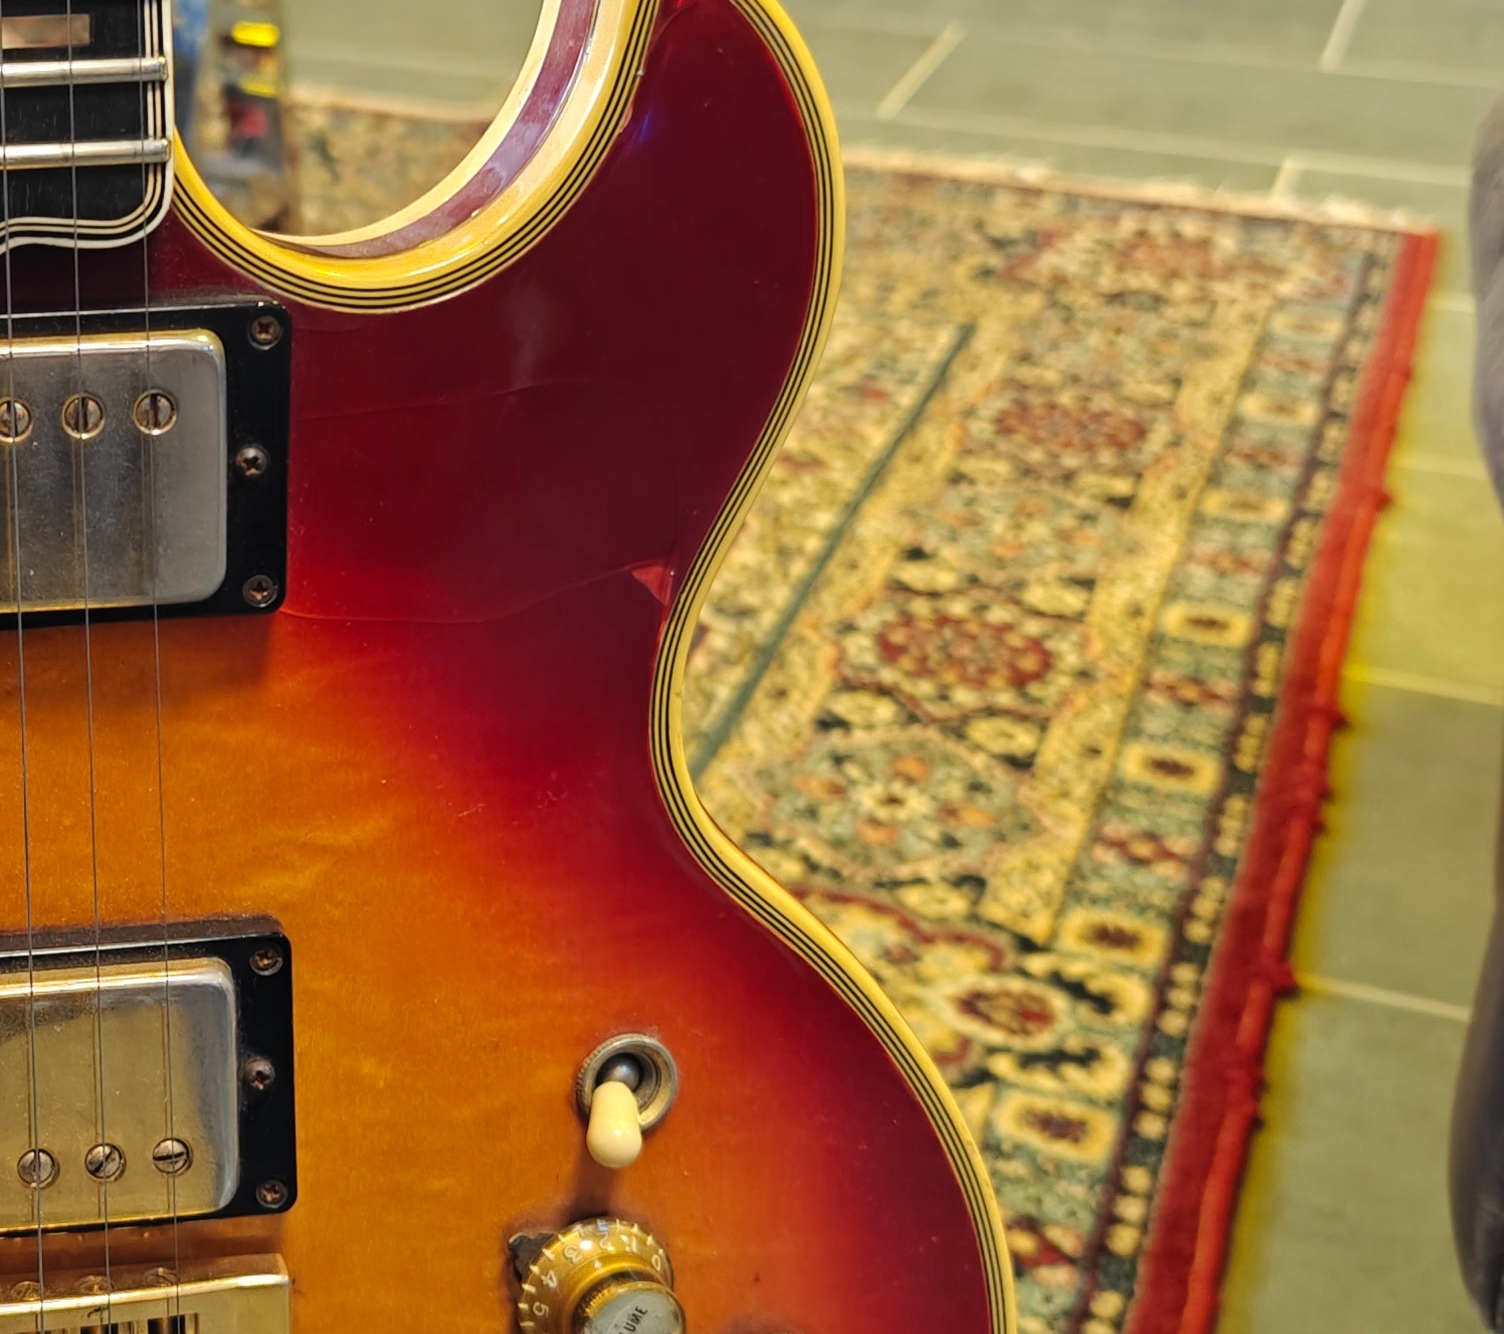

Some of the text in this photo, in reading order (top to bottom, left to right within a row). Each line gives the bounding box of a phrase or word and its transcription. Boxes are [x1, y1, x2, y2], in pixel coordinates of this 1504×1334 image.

[564, 1245, 581, 1263] 3
[541, 1270, 557, 1288] 4
[532, 1302, 549, 1317] 5
